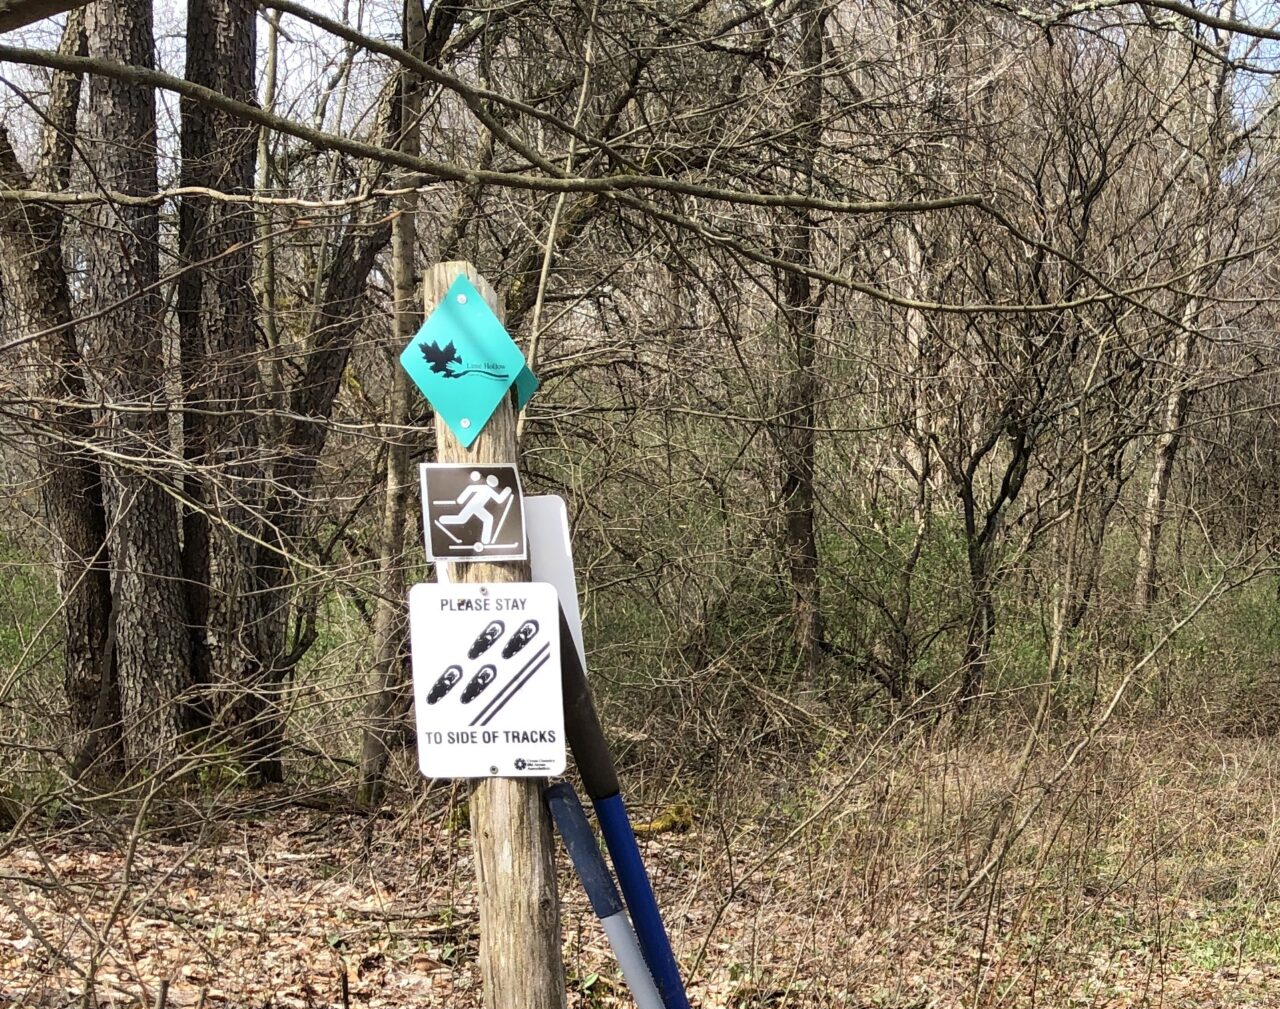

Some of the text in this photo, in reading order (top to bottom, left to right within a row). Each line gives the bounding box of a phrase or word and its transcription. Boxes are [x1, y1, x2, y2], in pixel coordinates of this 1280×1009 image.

[440, 598, 527, 611] PLEASE STAY
[425, 730, 556, 745] TO SIDE OF TRACKS
